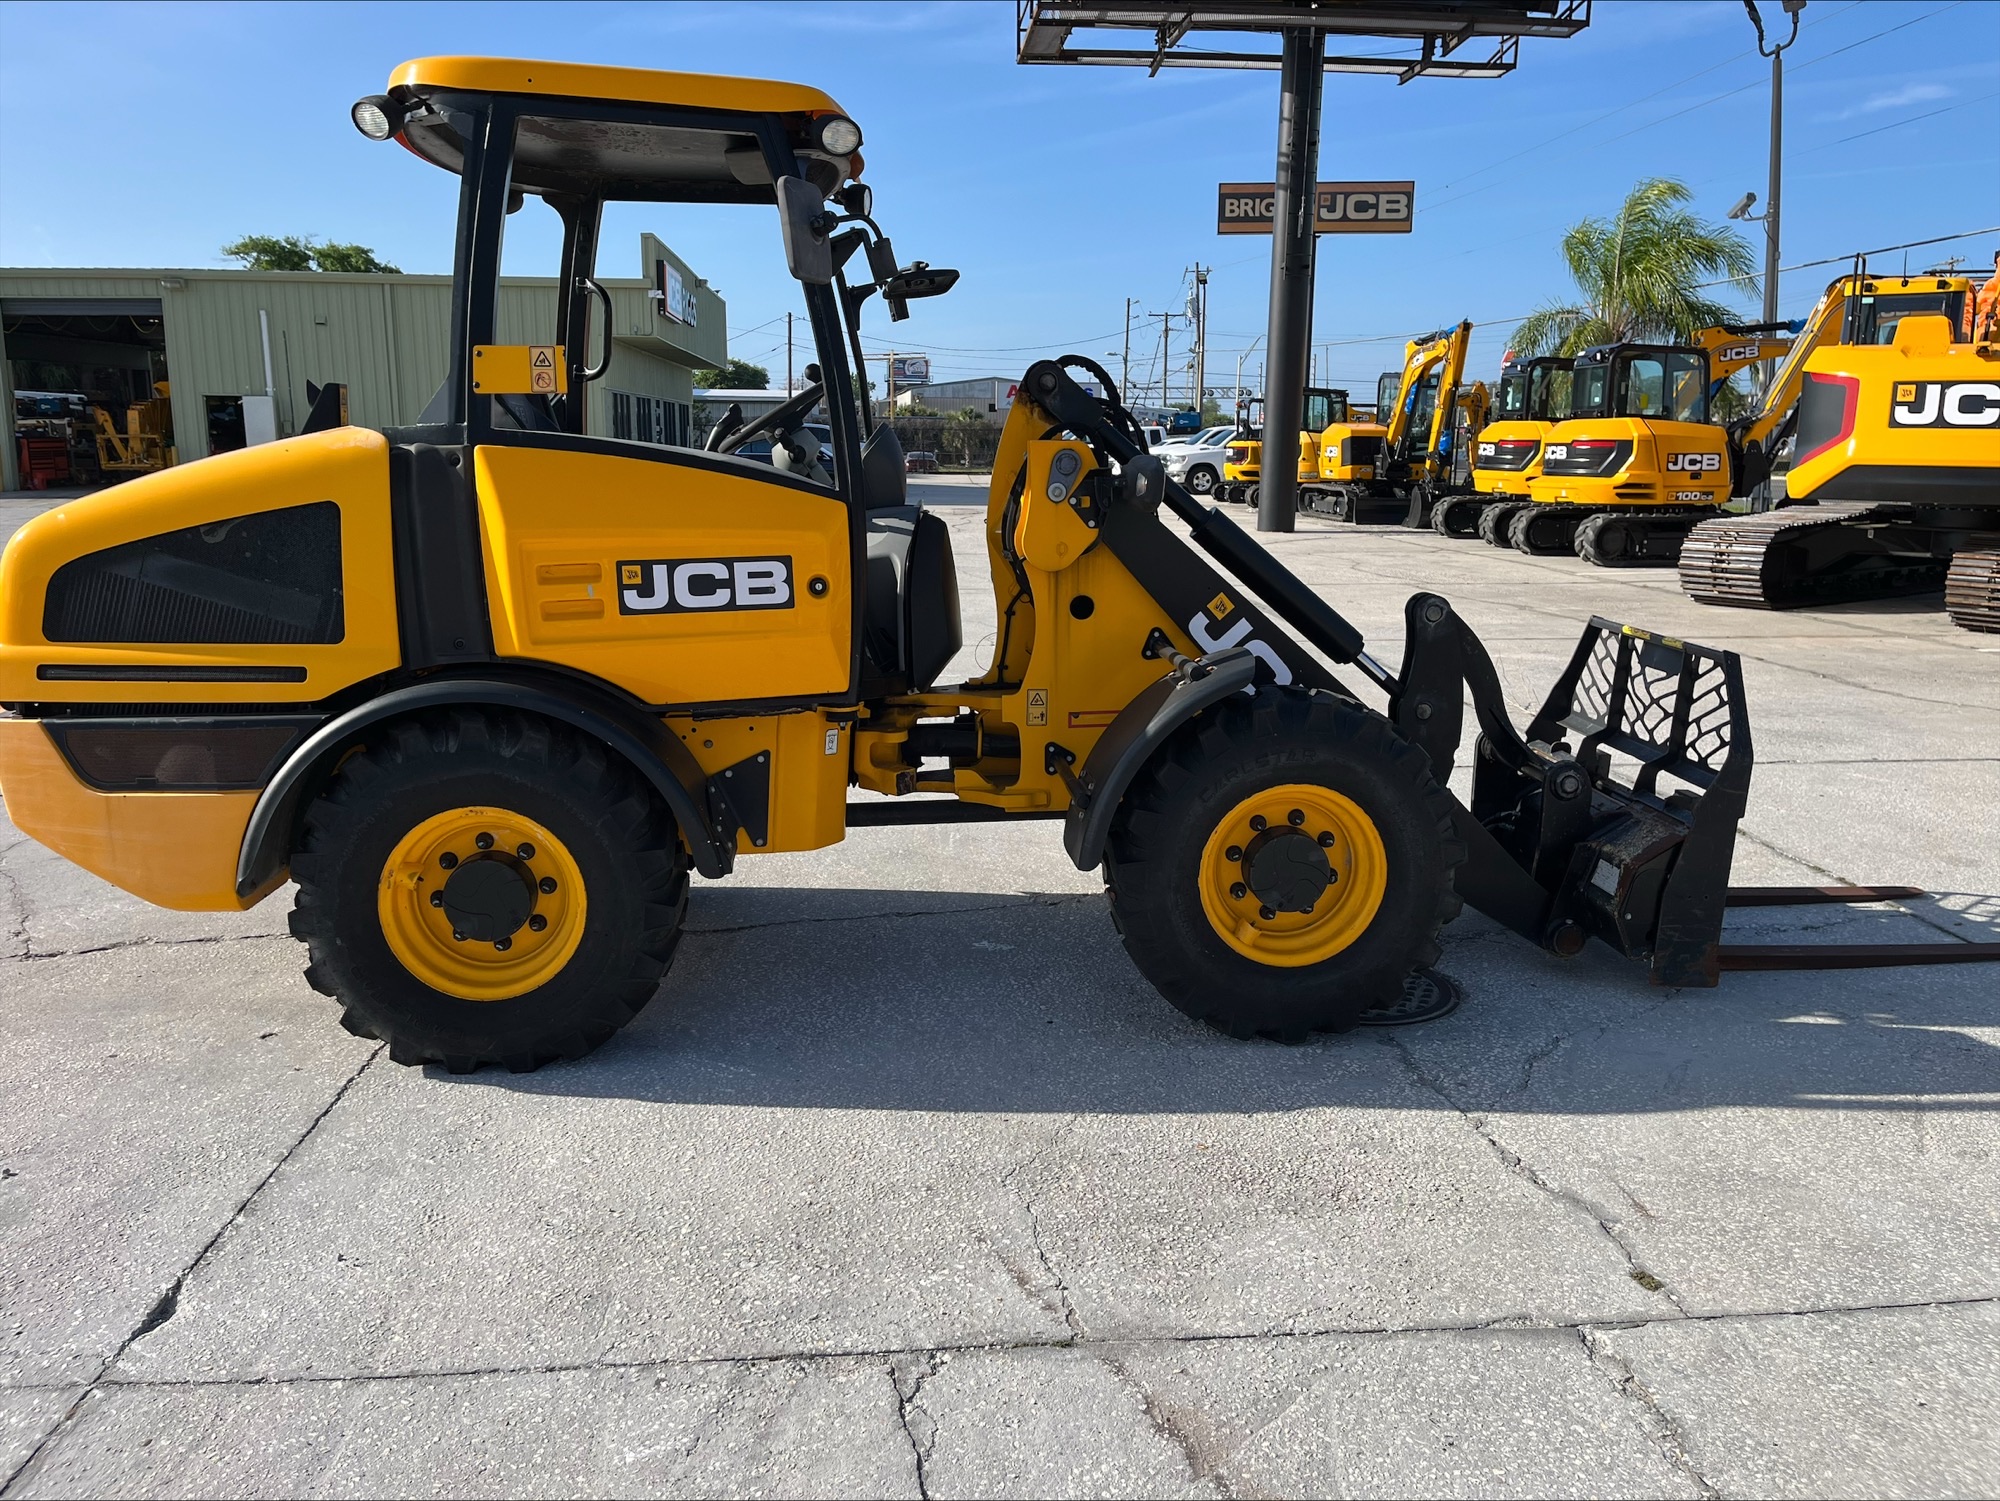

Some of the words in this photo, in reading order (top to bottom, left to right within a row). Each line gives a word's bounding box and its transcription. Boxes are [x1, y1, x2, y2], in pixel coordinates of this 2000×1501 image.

[1224, 197, 1276, 218] BRIG
[1319, 193, 1409, 220] JCB
[1719, 345, 1760, 362] JCB
[1893, 383, 2000, 425] JC
[1667, 453, 1720, 471] JCB
[1676, 491, 1701, 501] 100
[622, 560, 791, 610] JCB
